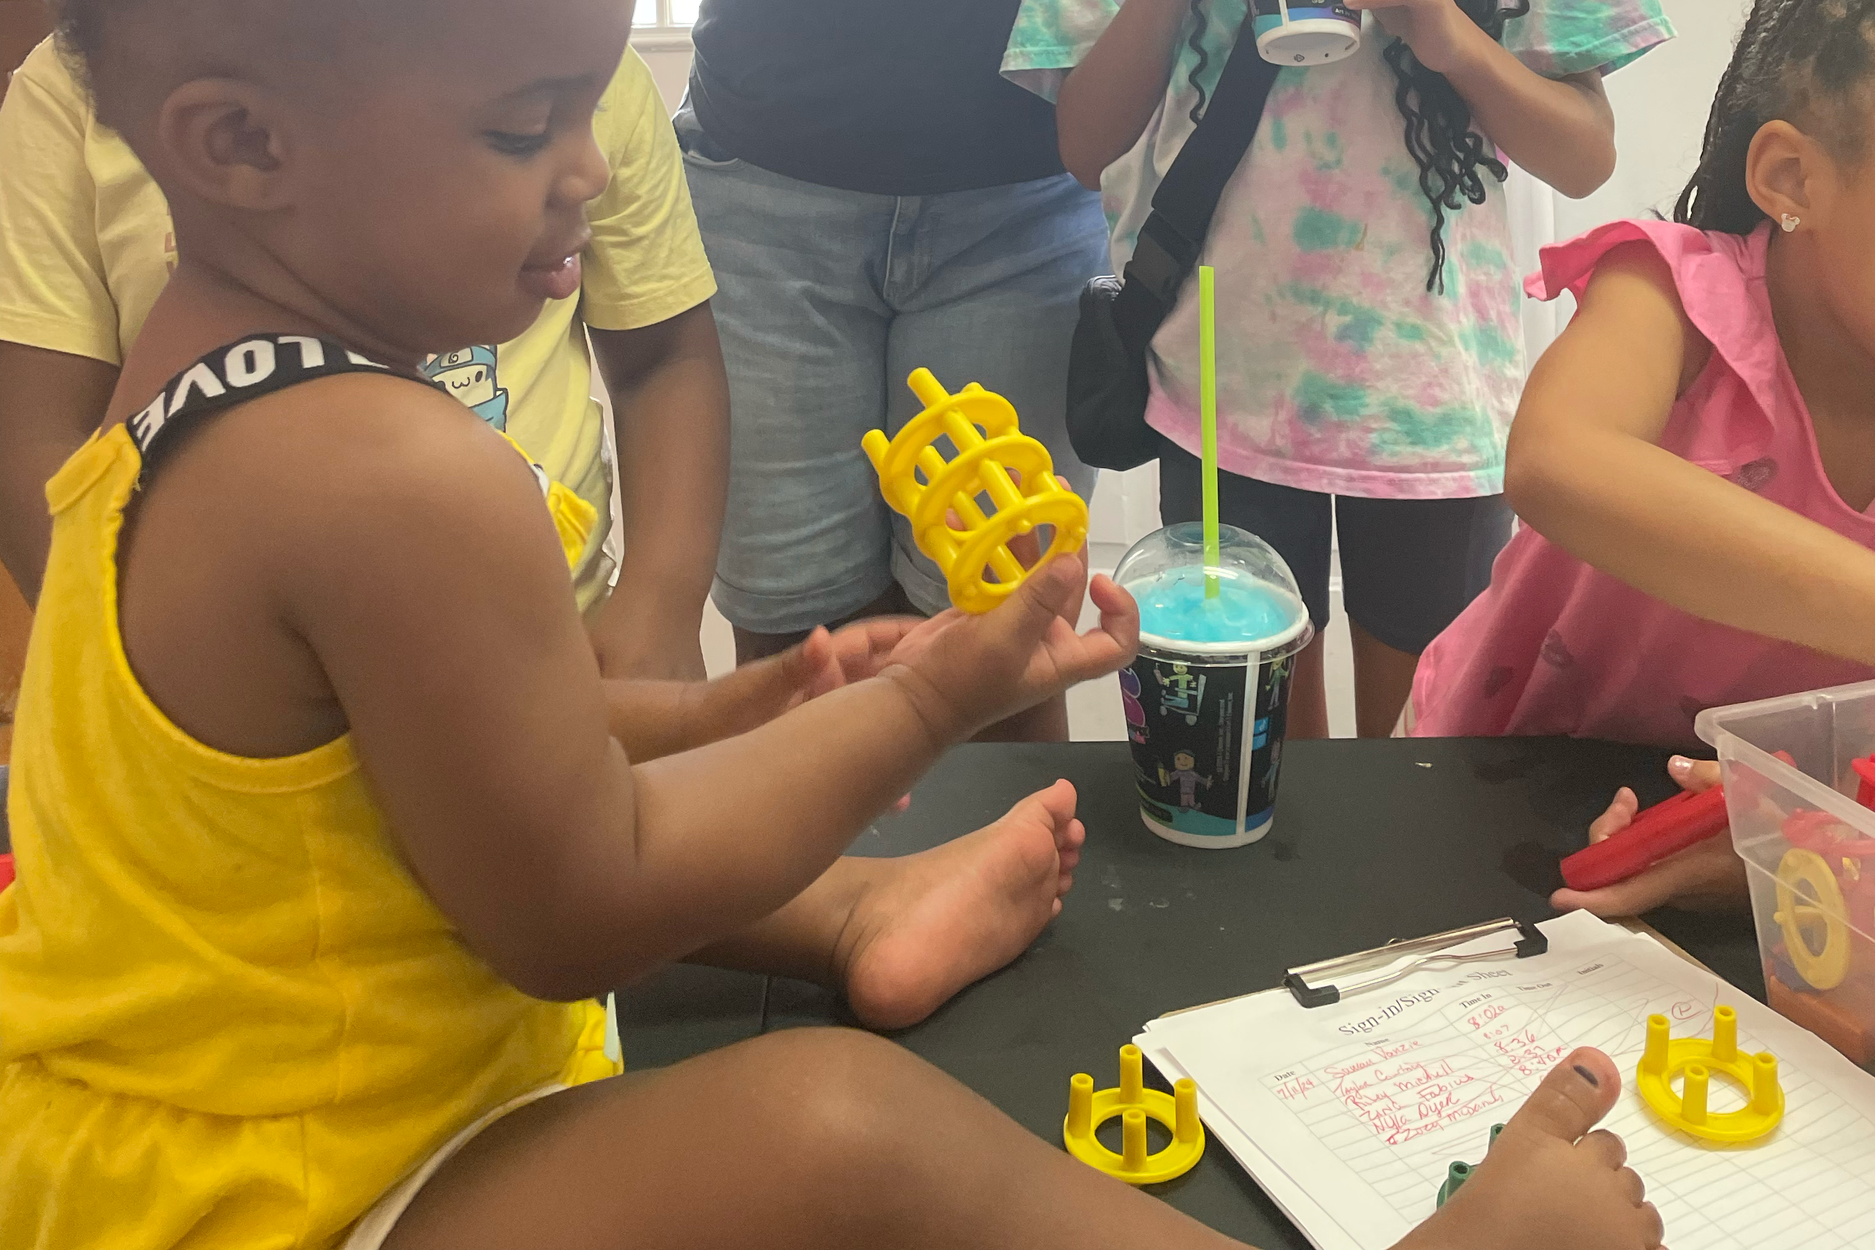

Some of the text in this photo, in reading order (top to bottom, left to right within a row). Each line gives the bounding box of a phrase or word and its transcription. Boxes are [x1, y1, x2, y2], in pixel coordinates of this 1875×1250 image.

[133, 335, 325, 452] LOVE
[1274, 1069, 1297, 1082] Date
[1365, 1037, 1390, 1048] Name
[1459, 996, 1481, 1010] Time
[1479, 992, 1492, 1001] In
[1577, 962, 1605, 976] Initials
